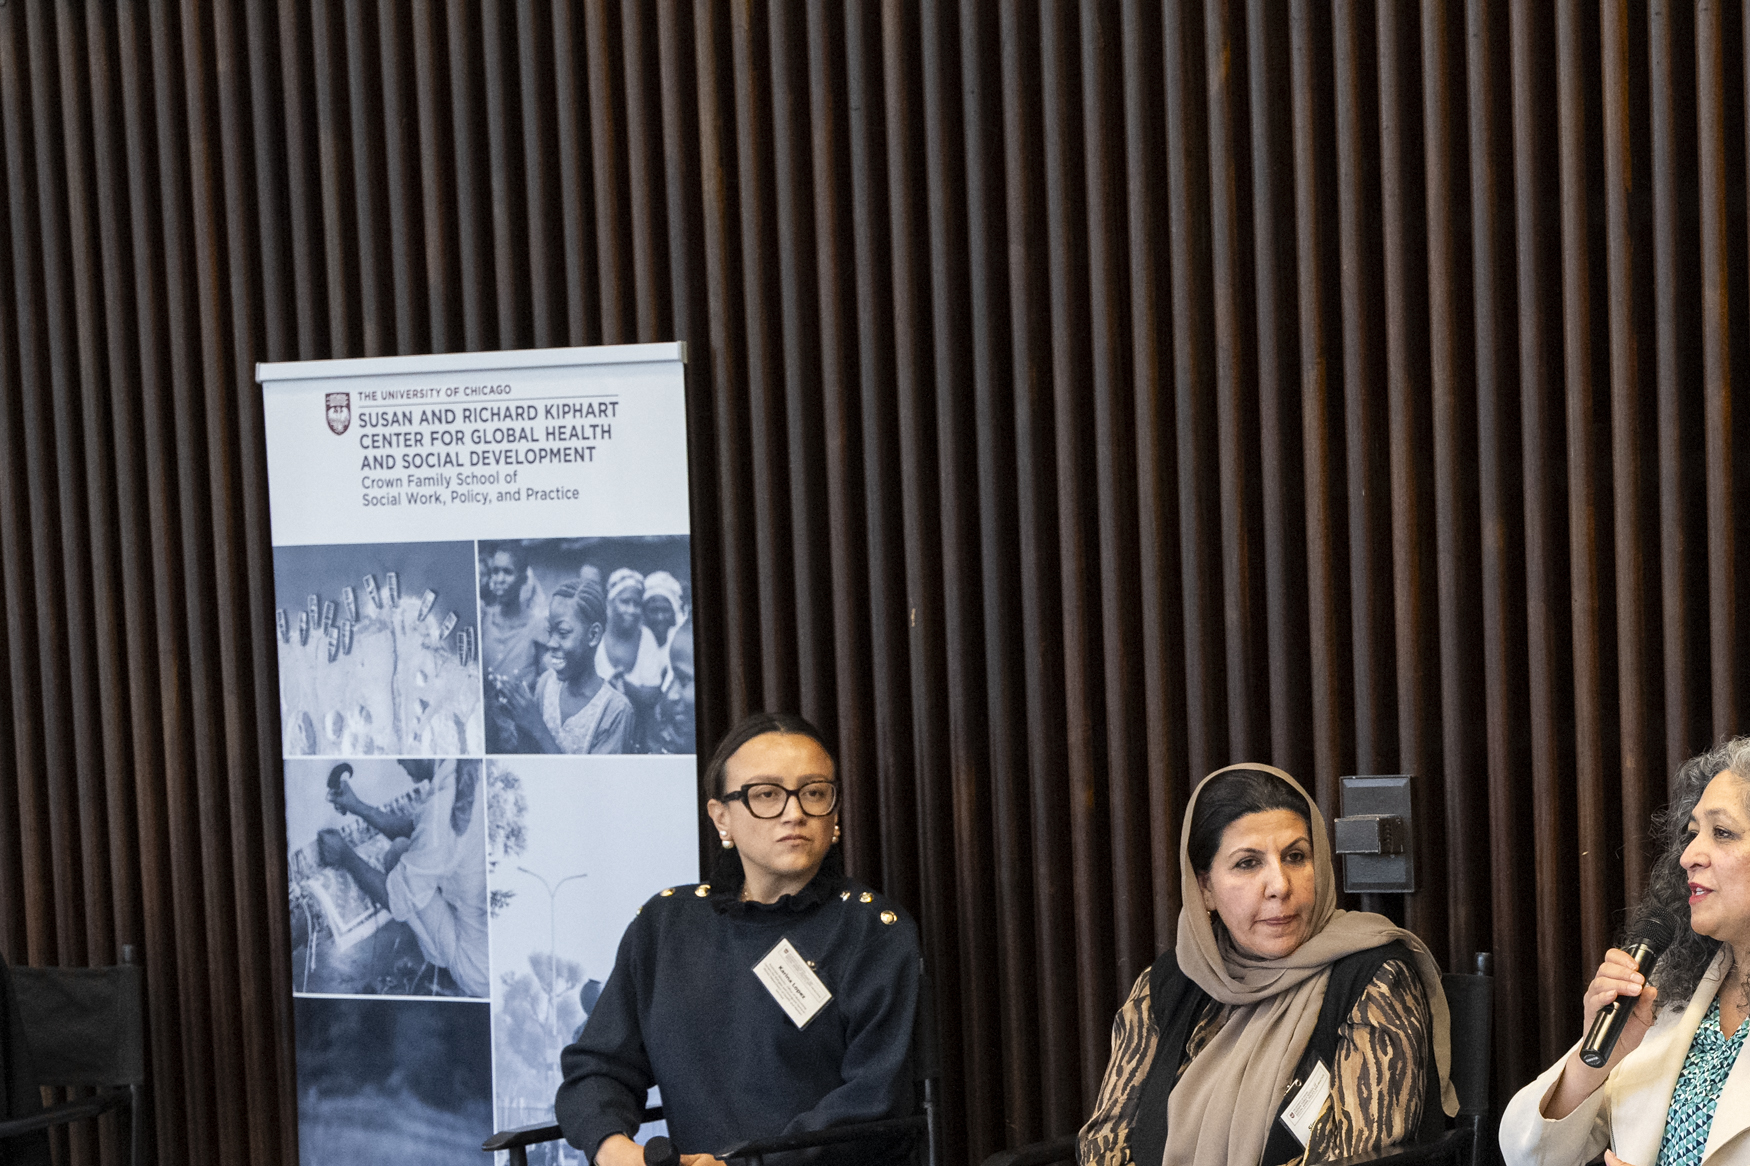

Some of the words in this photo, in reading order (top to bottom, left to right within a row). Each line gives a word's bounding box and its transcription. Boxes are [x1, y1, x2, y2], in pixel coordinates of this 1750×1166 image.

[358, 391, 378, 401] THE
[381, 388, 441, 400] UNIVERSITY
[445, 387, 460, 397] OF
[463, 384, 512, 396] CHICAGO
[359, 410, 413, 428] SUSAN
[419, 409, 457, 426] AND
[462, 405, 539, 424] RICHARD
[544, 401, 619, 420] KIPHART
[360, 432, 424, 450] CENTER
[430, 430, 465, 447] FOR
[471, 426, 540, 445] GLOBAL
[545, 423, 612, 442] HEALTH
[361, 454, 397, 471] AND
[402, 451, 465, 469] SOCIAL
[470, 446, 596, 467] DEVELOPMENT
[361, 475, 403, 489] Crown
[407, 472, 452, 489] Family
[456, 470, 500, 486] School
[504, 469, 518, 484] of
[362, 492, 402, 507] Social
[405, 491, 447, 506] Work,
[450, 488, 493, 506] Policy,
[496, 487, 521, 502] and
[526, 486, 580, 501] Practice
[779, 965, 792, 983] Karina
[791, 982, 805, 999] Lopez
